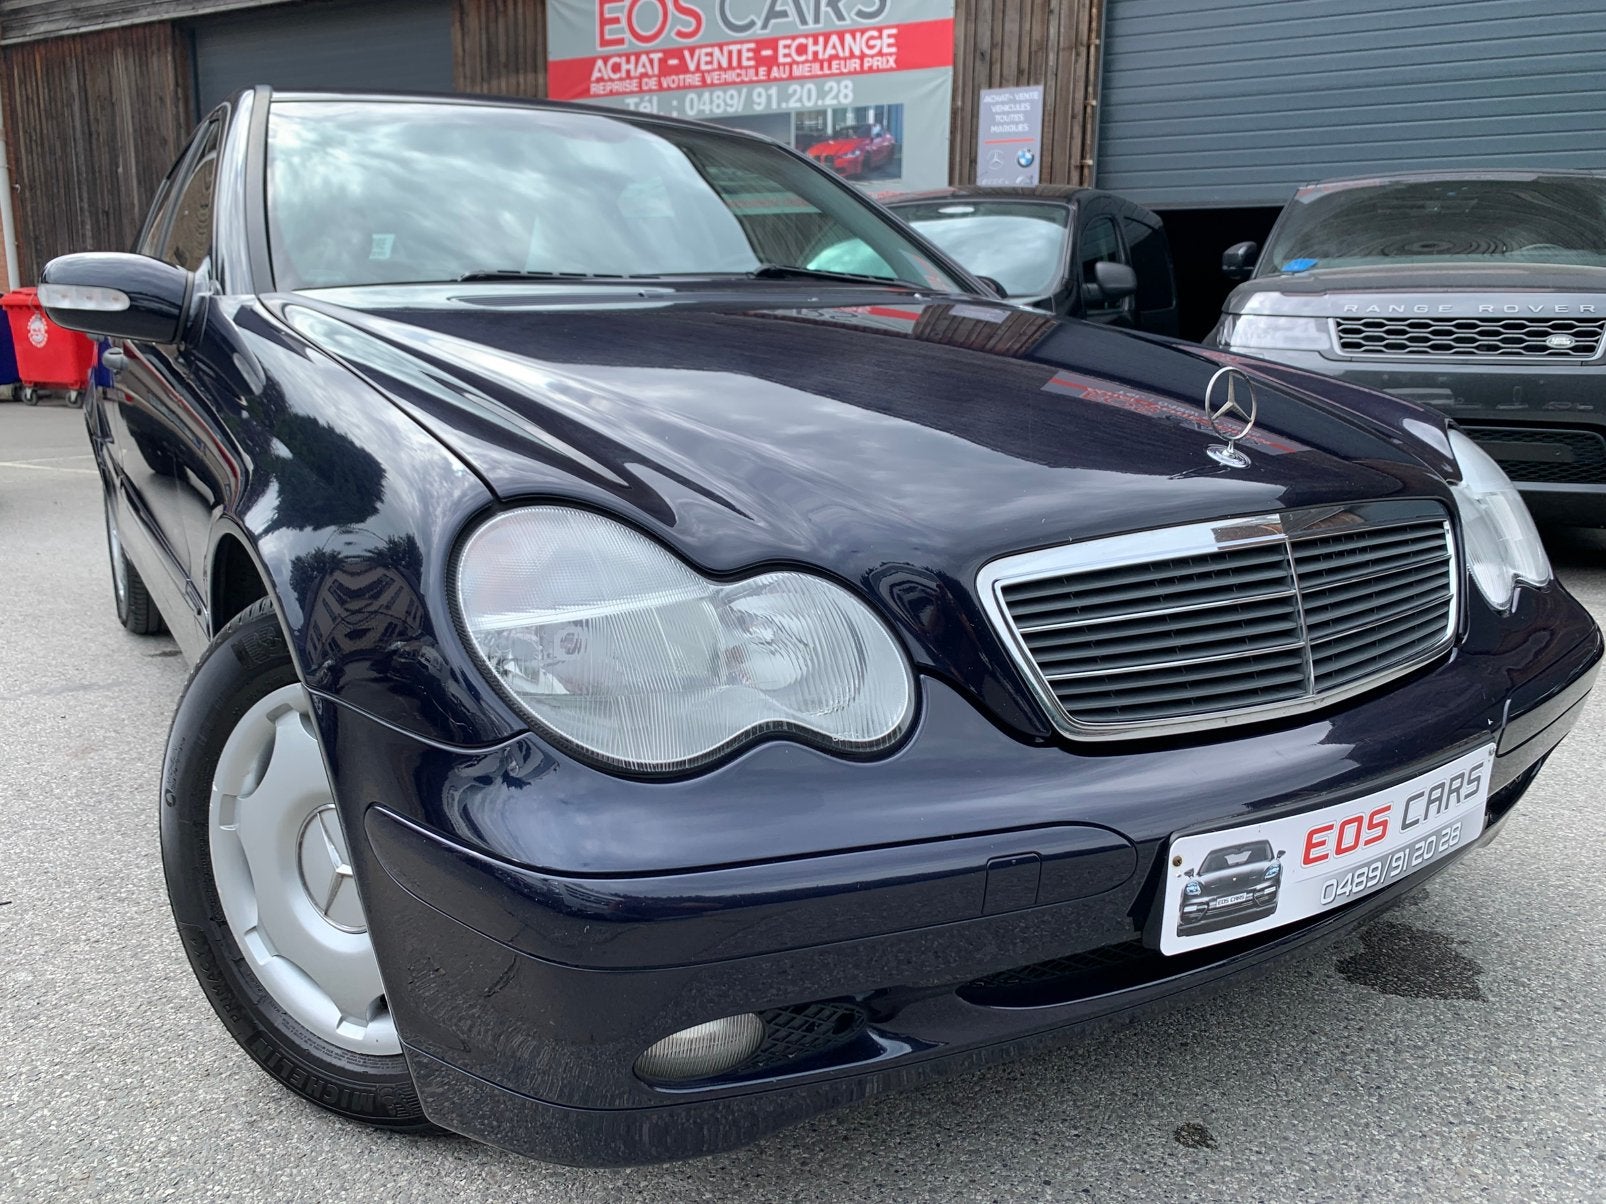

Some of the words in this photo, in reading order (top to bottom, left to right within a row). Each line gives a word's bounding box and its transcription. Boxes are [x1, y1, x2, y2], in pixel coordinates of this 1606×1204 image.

[596, 0, 705, 50] EOS
[590, 52, 664, 81] ACHAT
[683, 43, 756, 71] VENTE
[777, 28, 898, 63] ECHANGE
[590, 79, 640, 95] REPRISE
[641, 76, 660, 90] DE
[661, 73, 702, 88] VOTRE
[704, 66, 768, 84] VEHICULE
[770, 64, 790, 79] AU
[792, 58, 860, 76] MEILLEUR
[863, 55, 897, 70] PRIX
[684, 88, 747, 115] 0489/
[752, 80, 853, 111] 91.20.28
[1014, 91, 1039, 100] VENTE
[1343, 304, 1453, 313] RANGE
[1478, 304, 1596, 313] ROVER
[1301, 803, 1392, 868] EOS
[1399, 761, 1485, 832] CARS
[1411, 835, 1437, 865] 20
[1438, 822, 1462, 855] 28
[250, 1037, 375, 1113] MICHELIN
